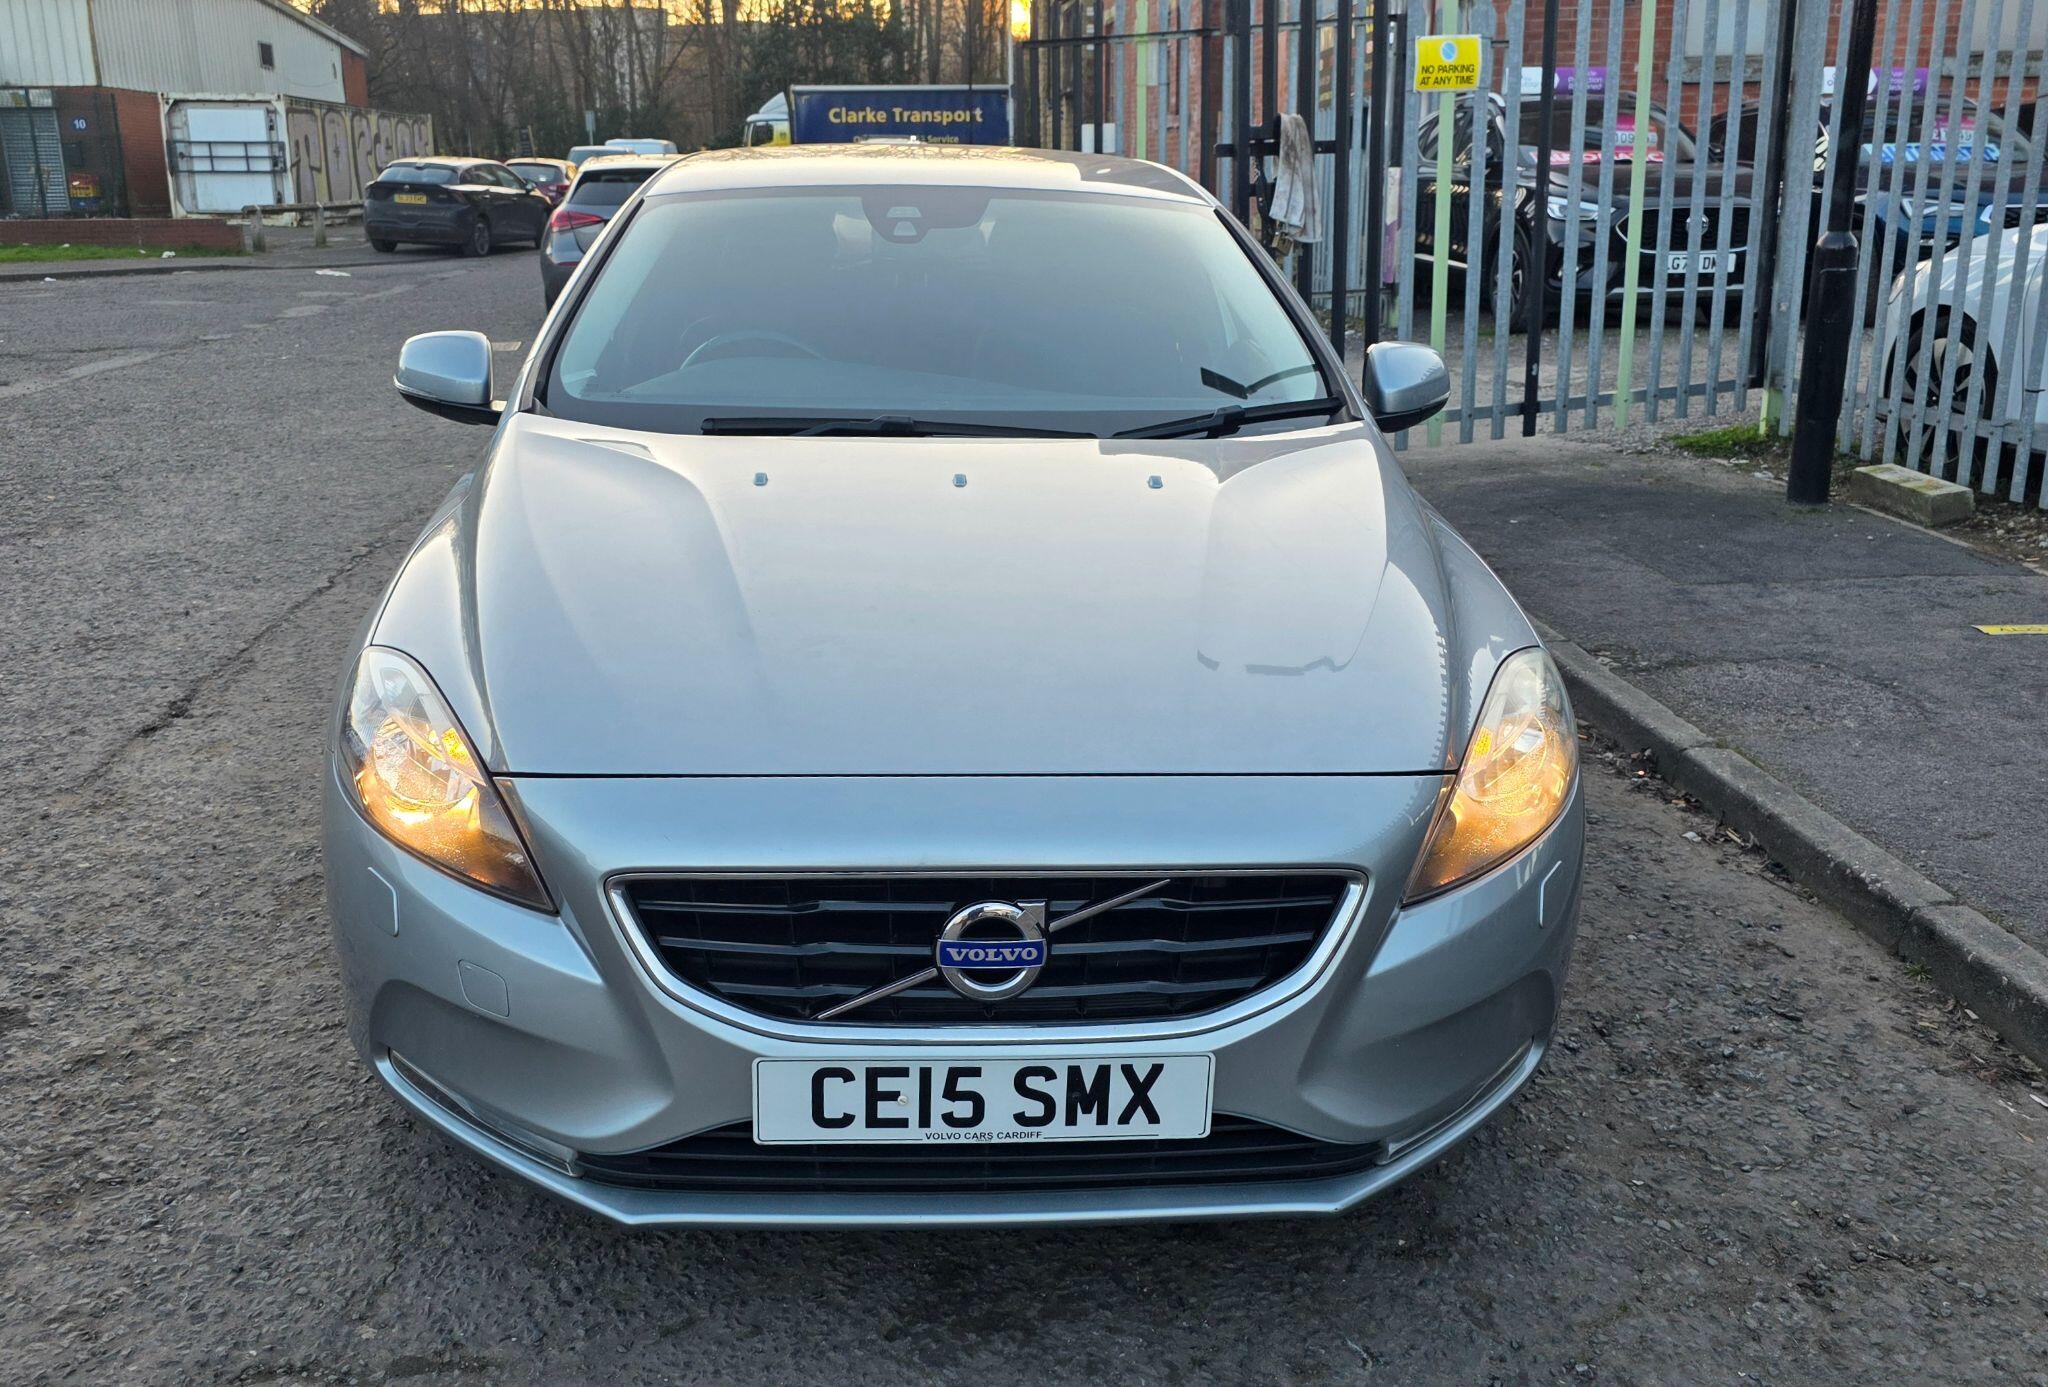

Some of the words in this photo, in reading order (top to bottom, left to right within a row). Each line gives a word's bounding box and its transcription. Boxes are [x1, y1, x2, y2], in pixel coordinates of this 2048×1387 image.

[1420, 65, 1435, 74] NO
[1437, 64, 1475, 74] PARKING
[1419, 76, 1431, 86] AT
[1433, 76, 1452, 85] ANY
[1455, 75, 1474, 85] TIME
[828, 107, 887, 124] Clarke
[73, 119, 86, 129] 10
[927, 135, 960, 144] Service
[945, 947, 1038, 962] VOLVO
[811, 1066, 985, 1130] CE15
[1012, 1063, 1165, 1128] SMX
[925, 1132, 961, 1141] VOLVO
[964, 1132, 994, 1140] CARS
[996, 1131, 1043, 1140] CARDIFF
